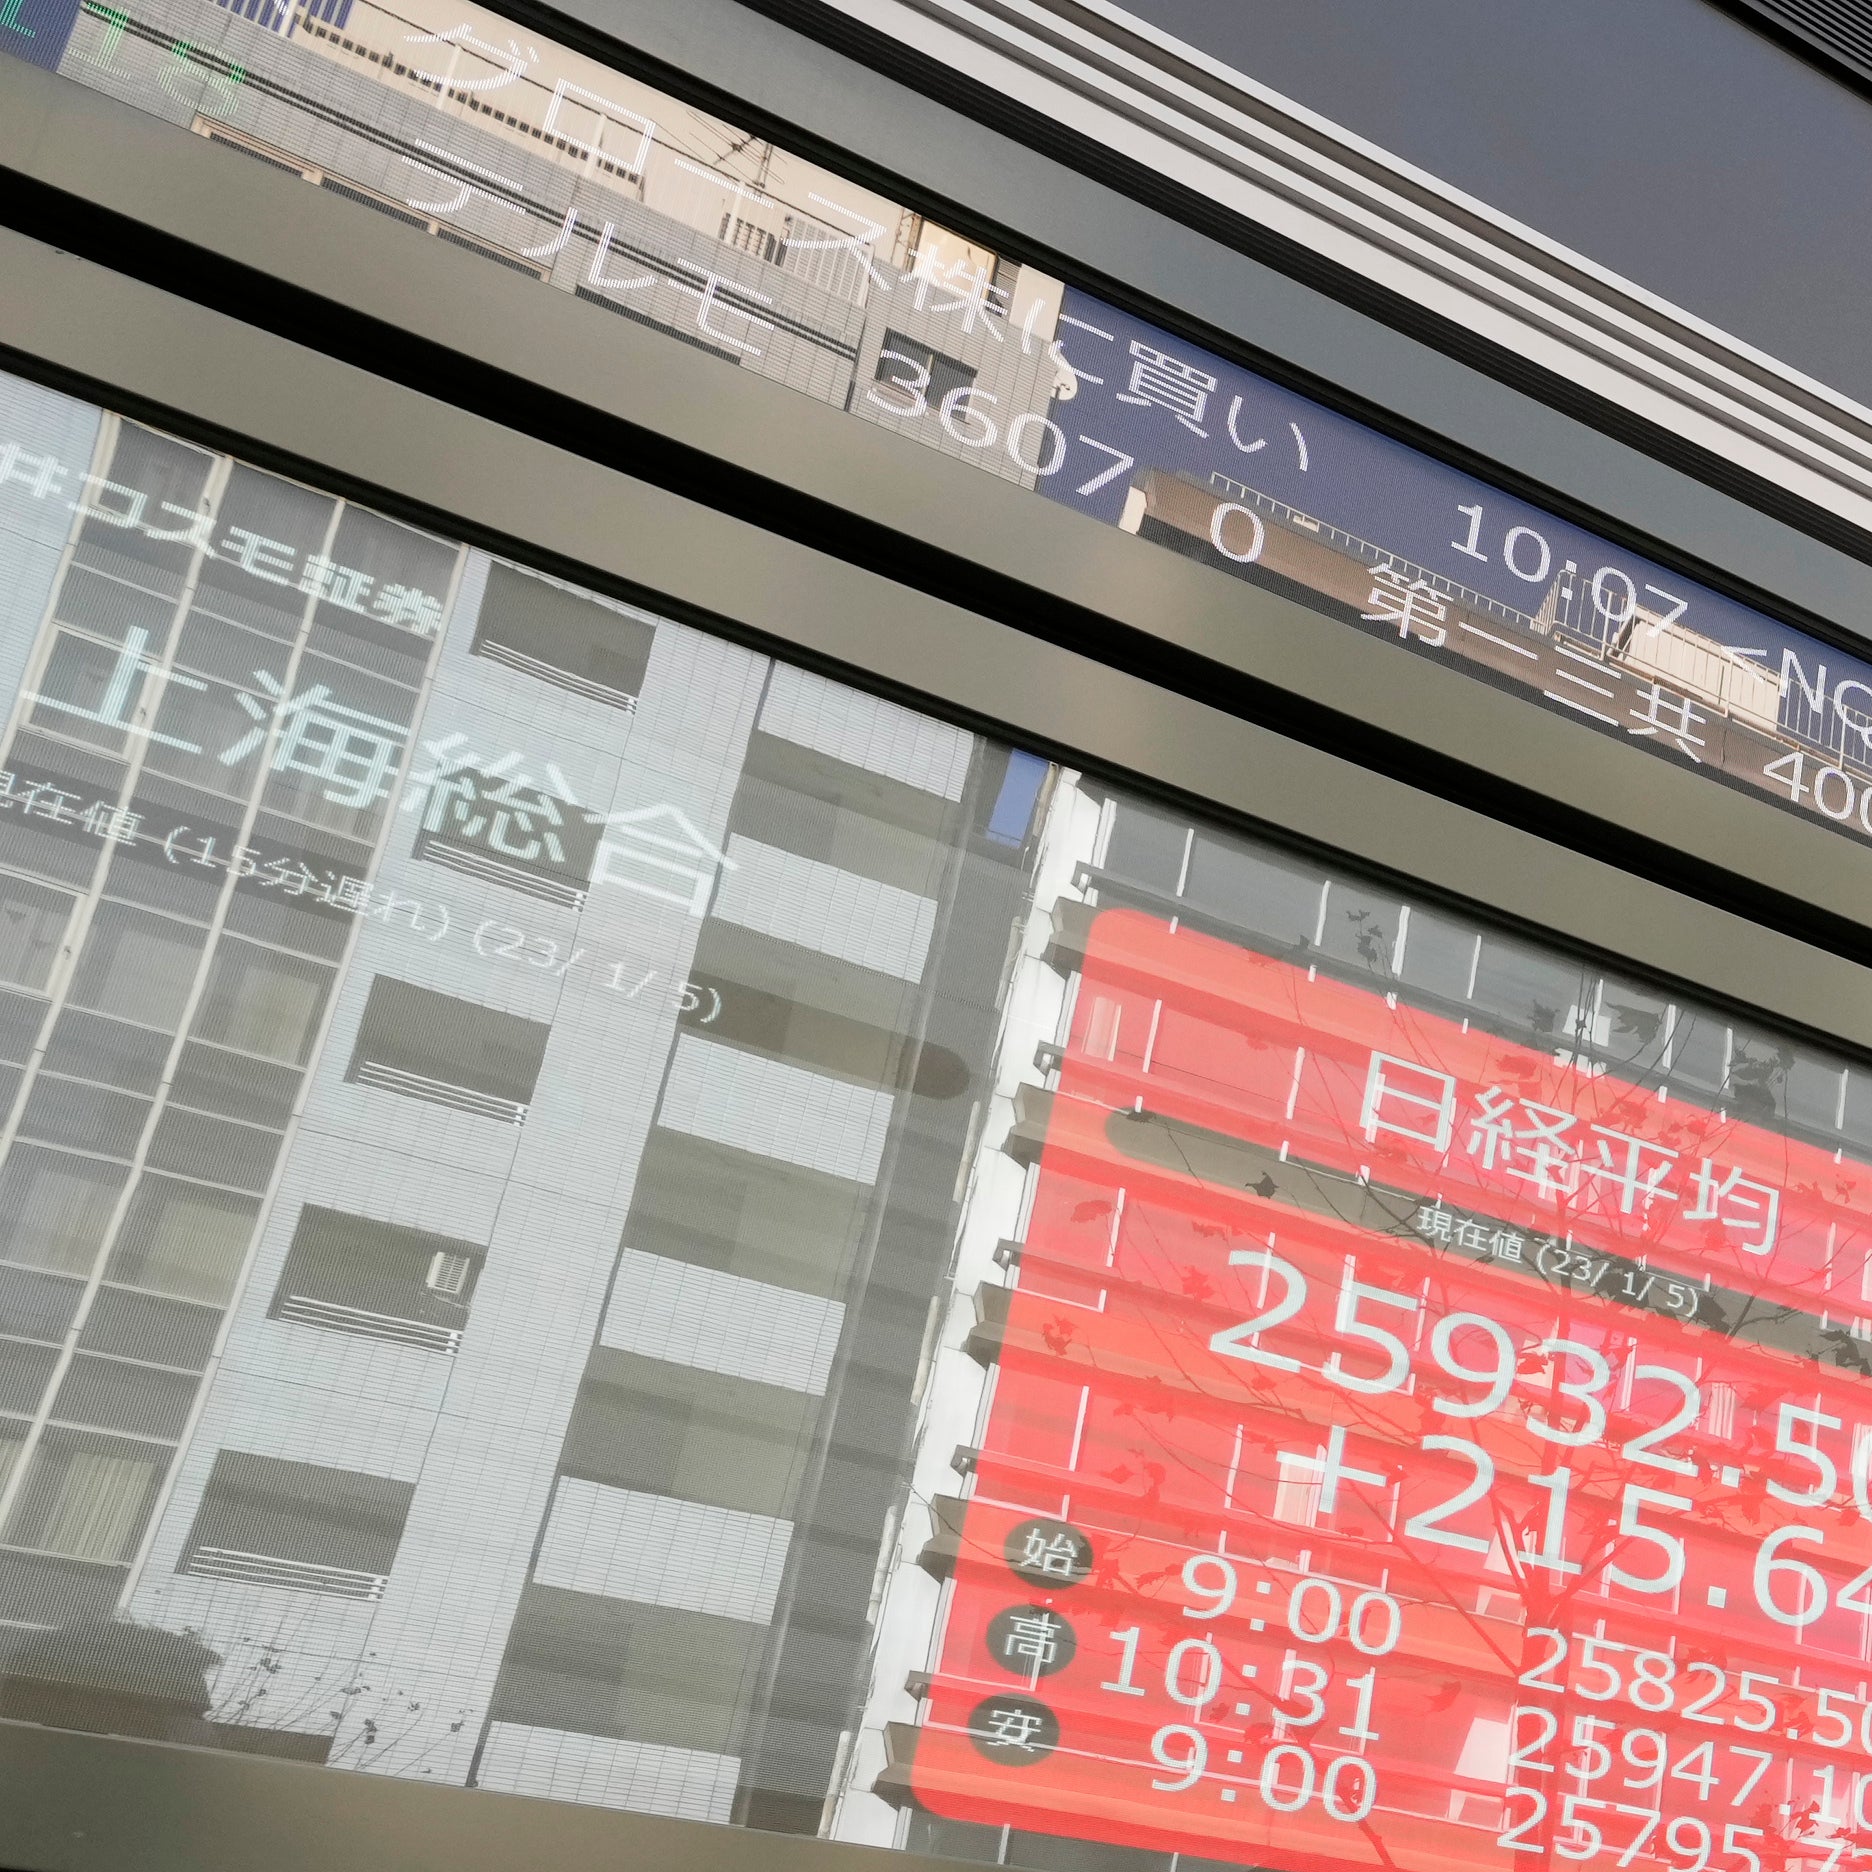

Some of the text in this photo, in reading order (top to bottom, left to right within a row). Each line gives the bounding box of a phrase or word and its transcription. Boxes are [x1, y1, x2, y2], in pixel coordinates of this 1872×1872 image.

[403, 22, 1310, 472] グロース株に買い
[1450, 503, 1689, 639] 10:07
[866, 348, 1135, 497] 3607
[1209, 501, 1266, 564] 0
[1360, 561, 1706, 764] 第一三共
[18, 625, 740, 918] 上海総合
[1358, 1050, 1782, 1257] 日経平均
[1004, 1613, 1062, 1665] 高
[1099, 1626, 1380, 1741] 10:31
[1020, 1528, 1081, 1577] 始
[1180, 1553, 1402, 1657] 9:00
[986, 1707, 1044, 1752] 安
[1151, 1724, 1377, 1823] 9:00
